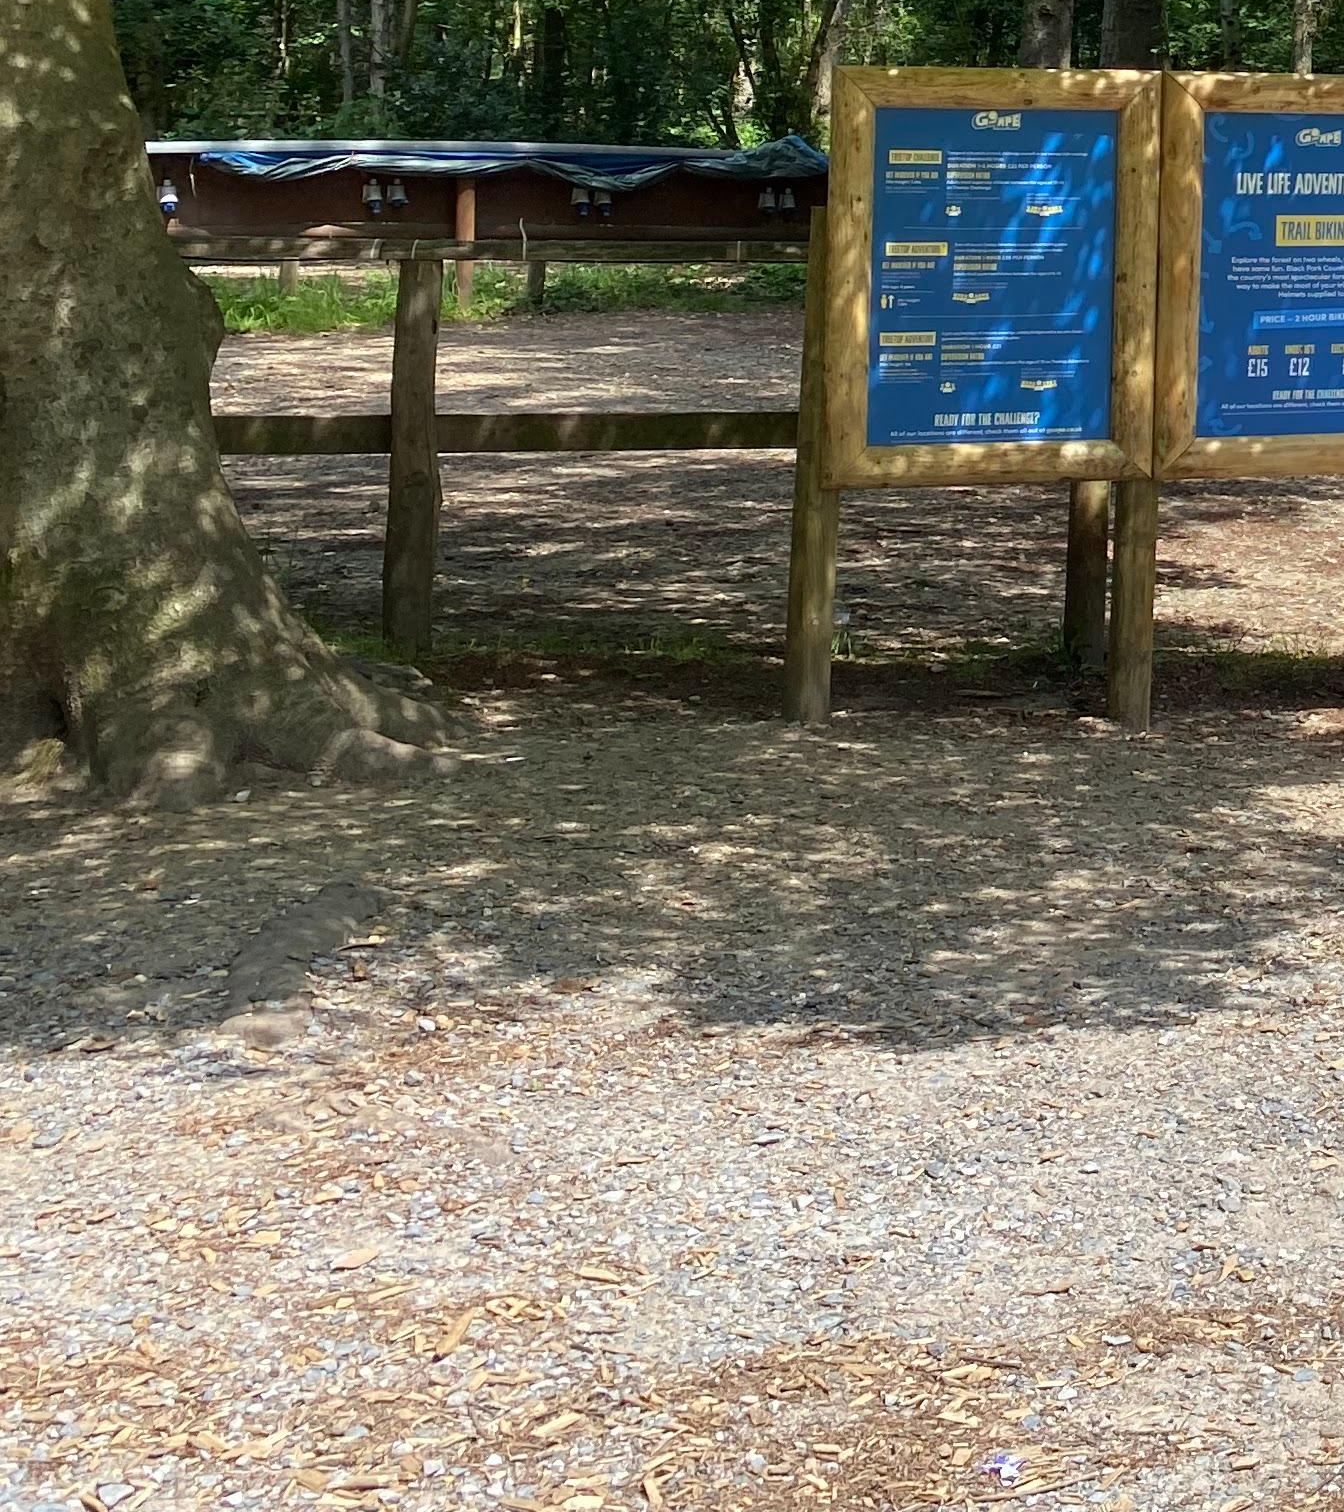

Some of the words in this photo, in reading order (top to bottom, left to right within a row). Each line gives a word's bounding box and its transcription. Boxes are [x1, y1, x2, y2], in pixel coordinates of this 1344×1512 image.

[997, 113, 1021, 128] APE
[1320, 131, 1341, 144] APE
[1236, 173, 1263, 194] LIVE
[1267, 173, 1291, 195] LIFE
[1281, 221, 1311, 241] TRAIL
[1231, 256, 1257, 264] Explore
[1260, 315, 1285, 324] PRICE
[1295, 315, 1300, 323] 2
[1301, 314, 1327, 322] HOUR
[1247, 358, 1268, 377] £15
[1289, 358, 1310, 376] £12
[1272, 390, 1291, 400] READY
[1292, 390, 1304, 400] FOR
[1305, 390, 1315, 400] THE
[934, 414, 959, 426] READY
[961, 413, 976, 426] FOR
[978, 413, 992, 425] THE
[994, 411, 1040, 425] CHALLENGE?
